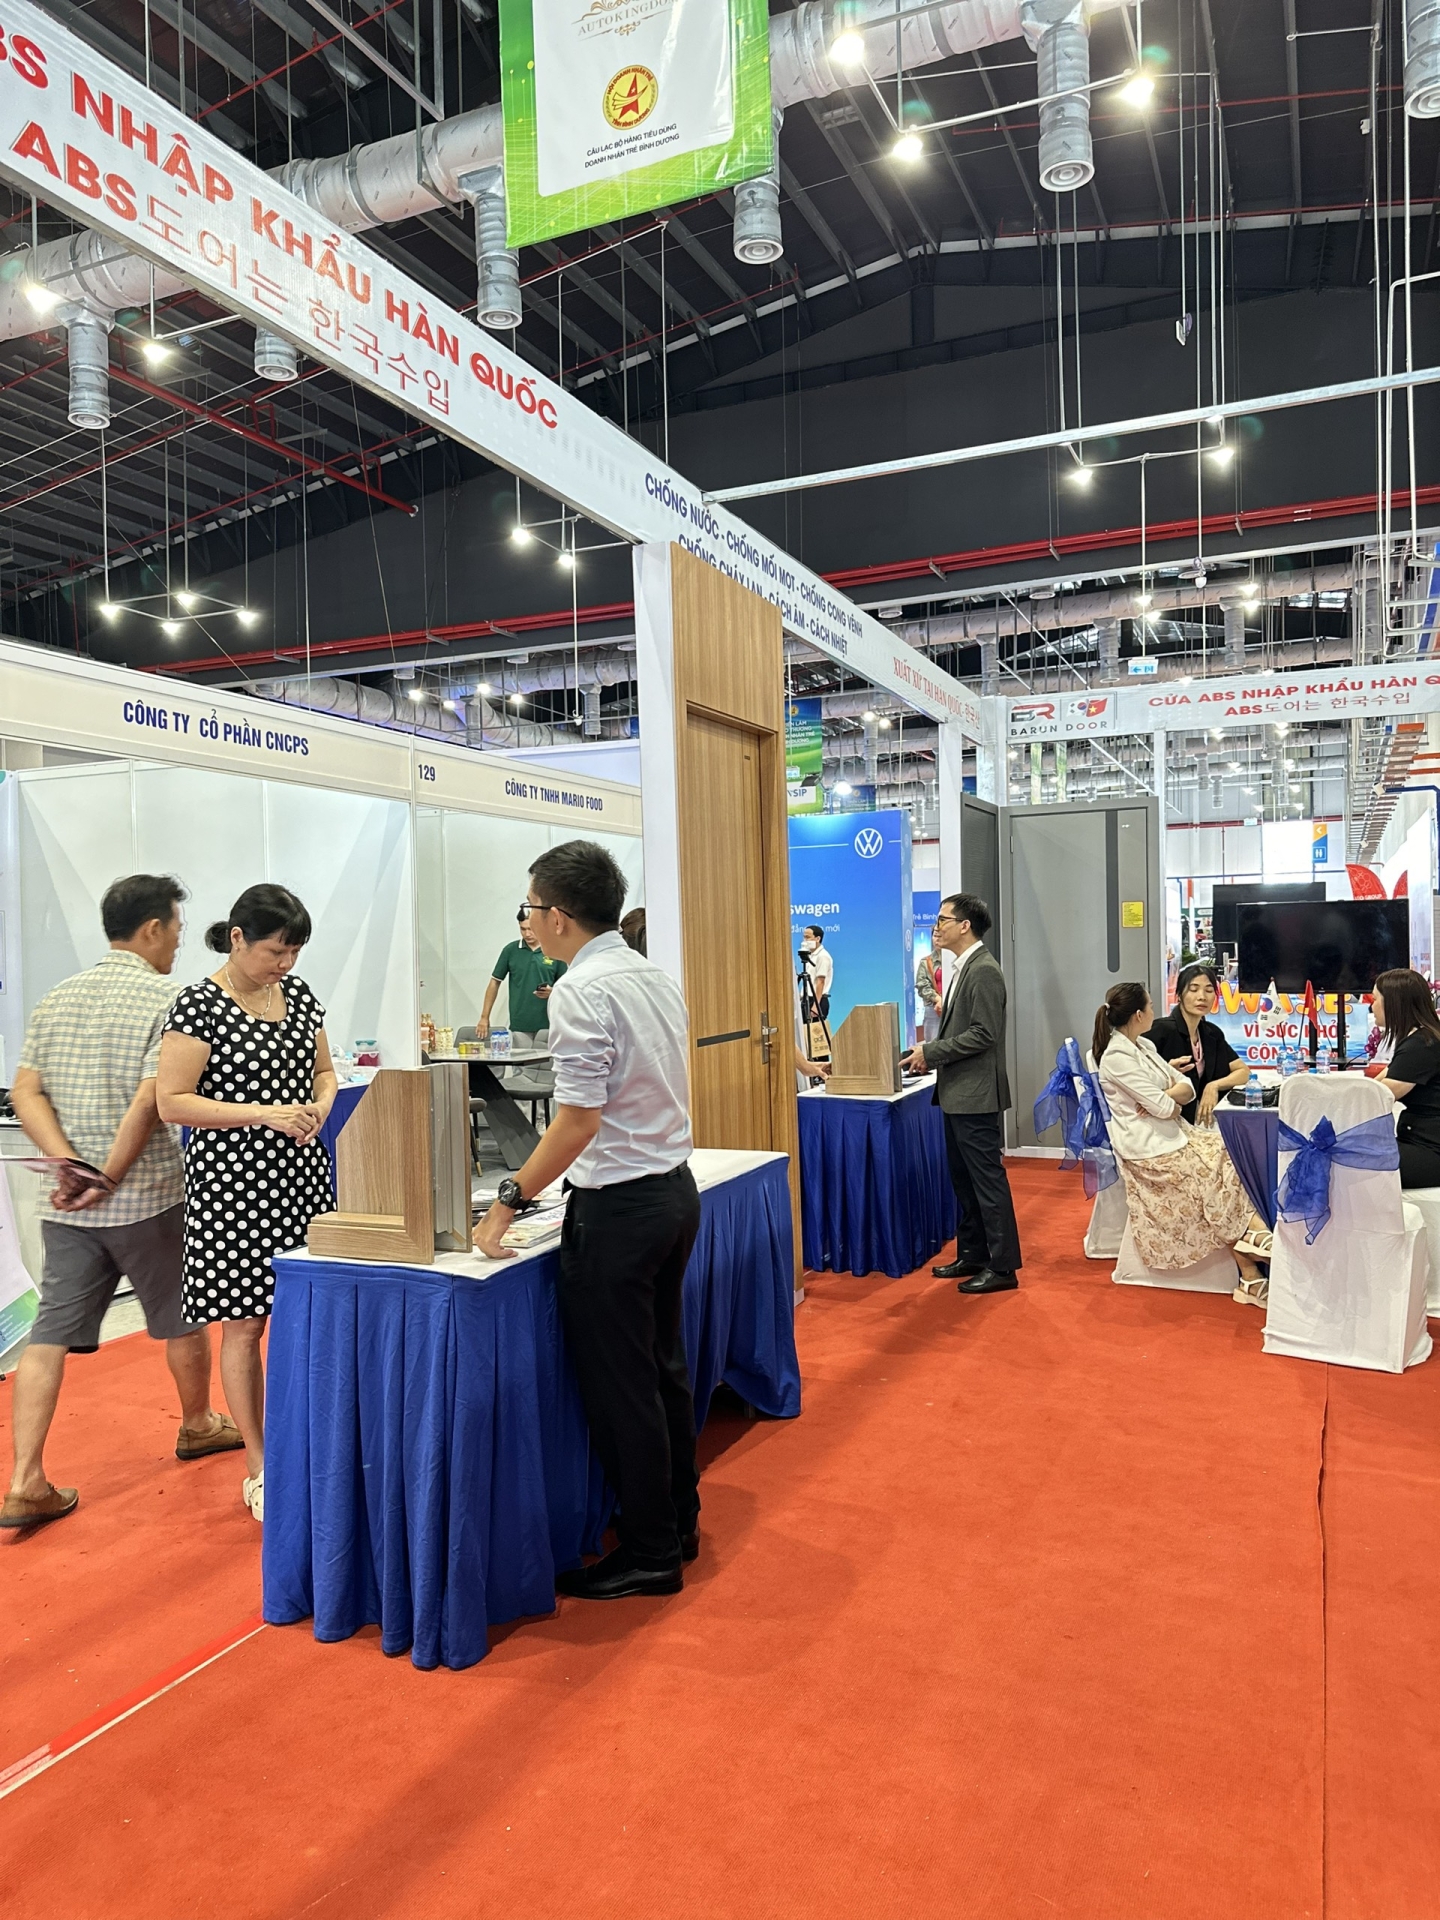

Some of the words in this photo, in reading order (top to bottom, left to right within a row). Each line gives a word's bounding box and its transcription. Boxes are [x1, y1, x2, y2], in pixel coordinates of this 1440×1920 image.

[585, 156, 606, 168] DOANH
[607, 150, 625, 160] NHÂN
[639, 140, 655, 151] BÌNH
[656, 133, 680, 147] DƯƠNG
[614, 139, 624, 148] BỘ
[624, 134, 642, 145] HÀNG
[659, 123, 677, 135] DÙNG
[0, 23, 48, 89] S
[70, 71, 234, 204] NHẬP
[251, 195, 371, 304] KHẨU
[385, 289, 459, 366] HÀN
[469, 352, 557, 429] QUỐC
[309, 297, 449, 416] 한국수입
[645, 472, 688, 518] CHỐNG
[690, 503, 720, 540] NƯỚC
[727, 530, 760, 568] CHỐNG
[762, 552, 778, 581] MỐI
[779, 567, 795, 594] MỌT
[801, 582, 826, 613] CHỐNG
[827, 601, 846, 627] CONG
[847, 613, 863, 638] VÊNH
[793, 604, 805, 630] ÂM
[810, 617, 830, 645] CÁCH
[831, 632, 848, 658] NHIỆT
[893, 656, 911, 684] XUẤT
[1148, 693, 1192, 707] CỬA
[1200, 692, 1236, 703] ABS
[1241, 684, 1299, 700] NHẬP
[1305, 677, 1364, 694] KHẨU
[1371, 675, 1418, 689] HÀN
[1330, 692, 1411, 709] 한국수입
[123, 699, 168, 730] CÔNG
[172, 711, 190, 734] TY
[199, 708, 219, 740] CỔ
[223, 718, 262, 747] PHẦN
[266, 731, 309, 756] CNCPS
[1011, 725, 1058, 736] BARUN
[1066, 721, 1108, 731] DOOR
[418, 764, 436, 782] 129
[505, 778, 528, 798] CÔNG
[529, 785, 538, 801] TY
[540, 787, 560, 804] TNHH
[561, 791, 585, 808] MARIO
[586, 796, 603, 811] FOOD
[825, 924, 840, 932] mới
[1244, 1021, 1259, 1038] VÌ
[1265, 1021, 1298, 1038] SỨC
